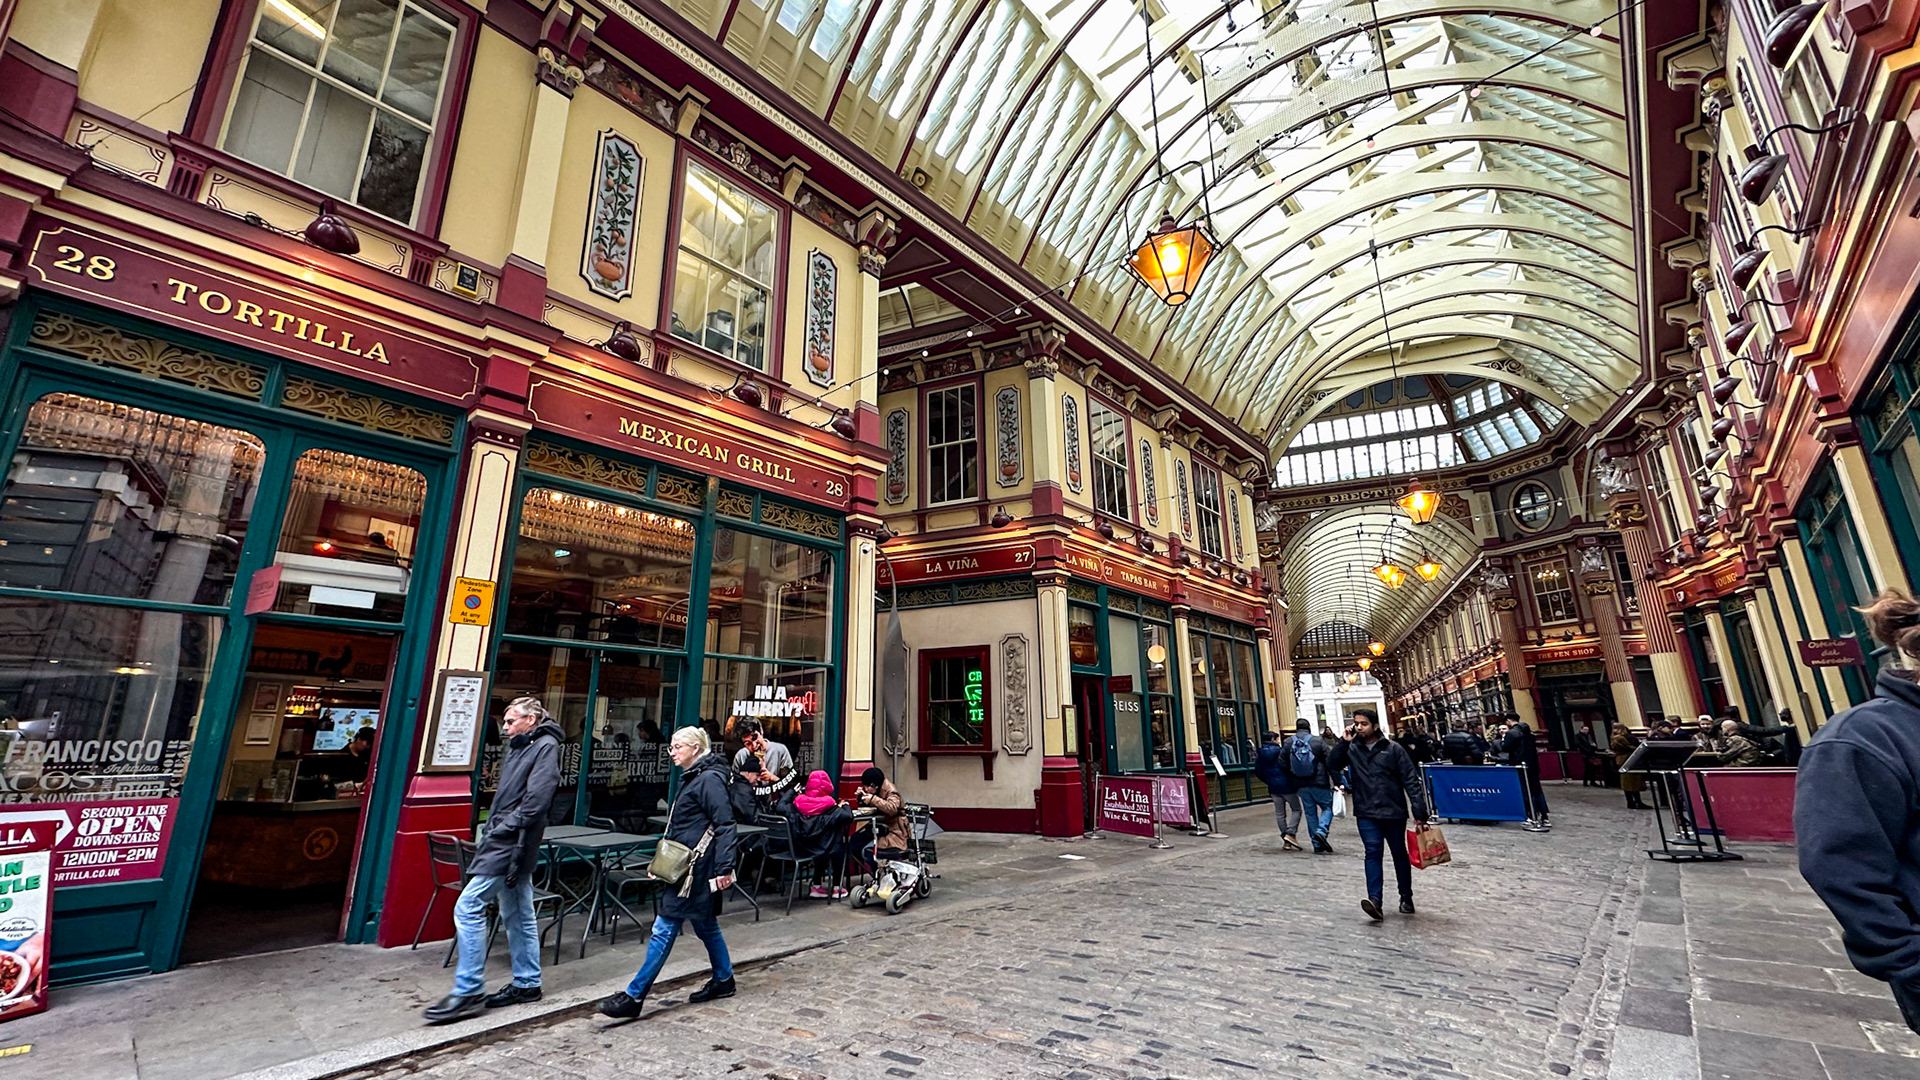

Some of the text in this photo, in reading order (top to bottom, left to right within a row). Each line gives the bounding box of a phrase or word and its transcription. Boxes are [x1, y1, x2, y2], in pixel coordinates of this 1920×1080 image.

[54, 246, 390, 365] 28 TORTILLA
[619, 417, 844, 497] MEXICAN GRILL 28
[926, 563, 943, 573] LA
[947, 557, 979, 570] VIÑA
[1015, 552, 1030, 563] 27
[1066, 553, 1099, 573] LA VIÑA
[460, 579, 492, 588] Pedestrian
[1105, 566, 1170, 593] 27 TAPAS BAR 27
[1212, 600, 1229, 611] REISS
[1808, 640, 1847, 649] Osteria
[1537, 648, 1595, 660] THE PEN SHOP
[1811, 657, 1855, 665] mercato
[755, 685, 787, 700] IN A
[732, 700, 803, 717] HURRY?
[1113, 701, 1139, 712] REISS
[4, 740, 163, 764] FRANCISCO
[595, 751, 621, 759] BRAISED
[103, 763, 159, 776] Infusion
[170, 740, 193, 787] CREAM
[628, 762, 656, 776] RICE
[773, 768, 798, 793] FRESH
[118, 784, 161, 798] RICE
[1105, 787, 1118, 800] La
[1121, 788, 1149, 804] Viña
[81, 805, 168, 819] SECOND LINE
[1104, 800, 1135, 810] Established
[1136, 803, 1150, 812] 2021
[1104, 811, 1150, 824] Wine & Tapas
[77, 815, 166, 836] OPEN
[73, 832, 161, 847] DOWNSTAIRS
